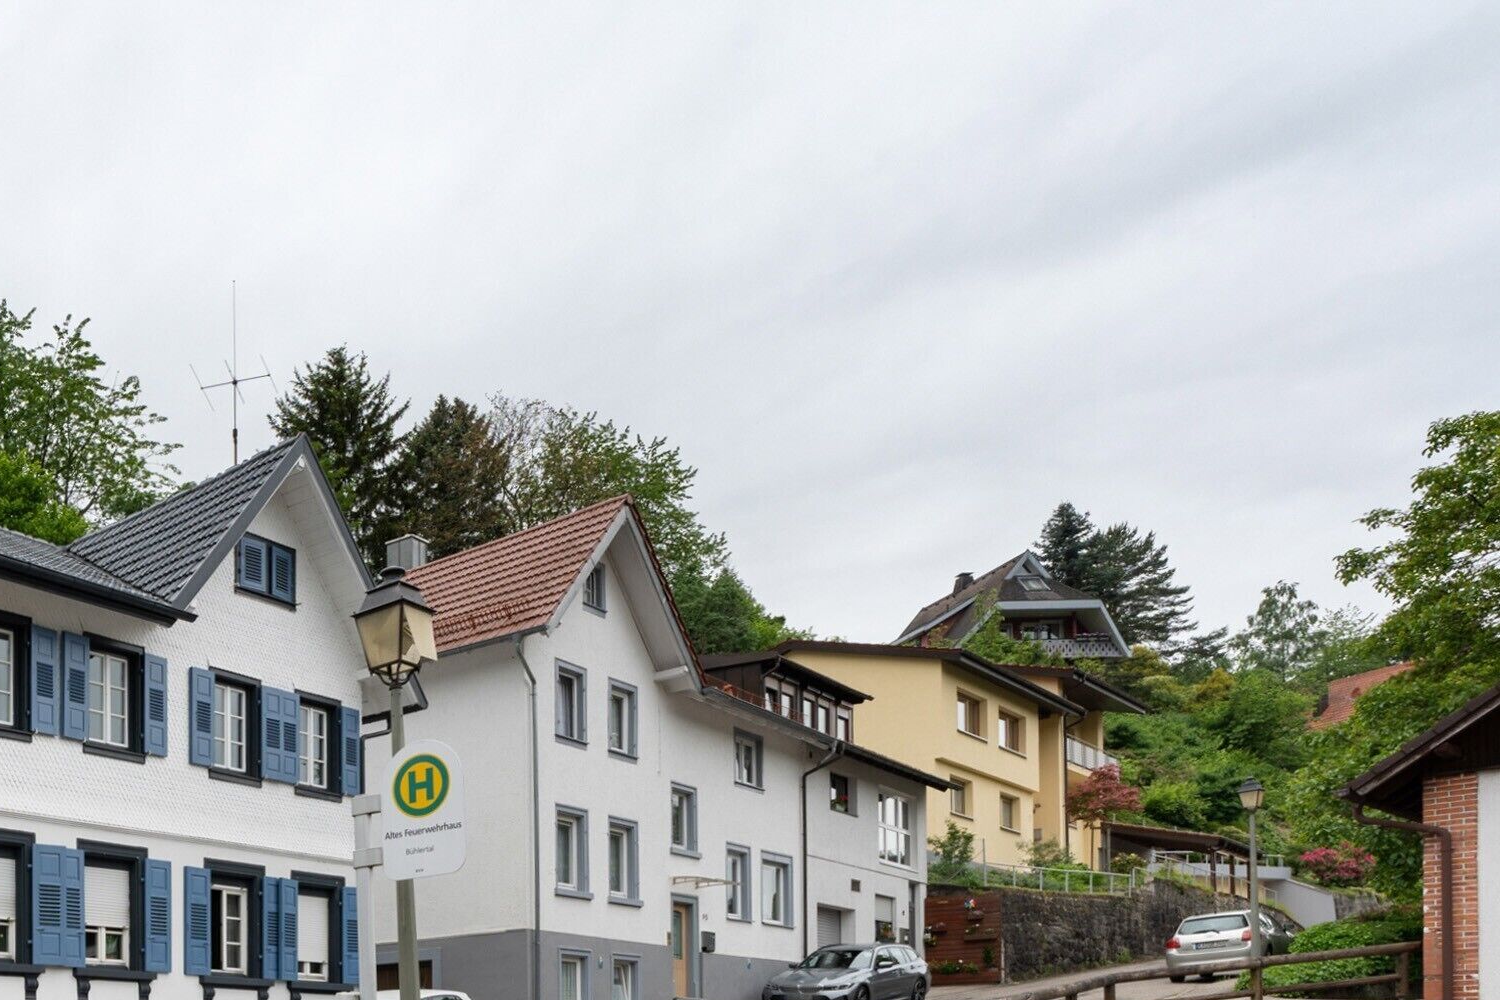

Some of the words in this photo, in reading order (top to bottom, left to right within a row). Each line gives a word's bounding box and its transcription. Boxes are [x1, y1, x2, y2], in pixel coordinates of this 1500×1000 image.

[408, 767, 434, 804] H
[385, 831, 403, 840] Altes
[404, 822, 462, 837] Feuerwehrhaus
